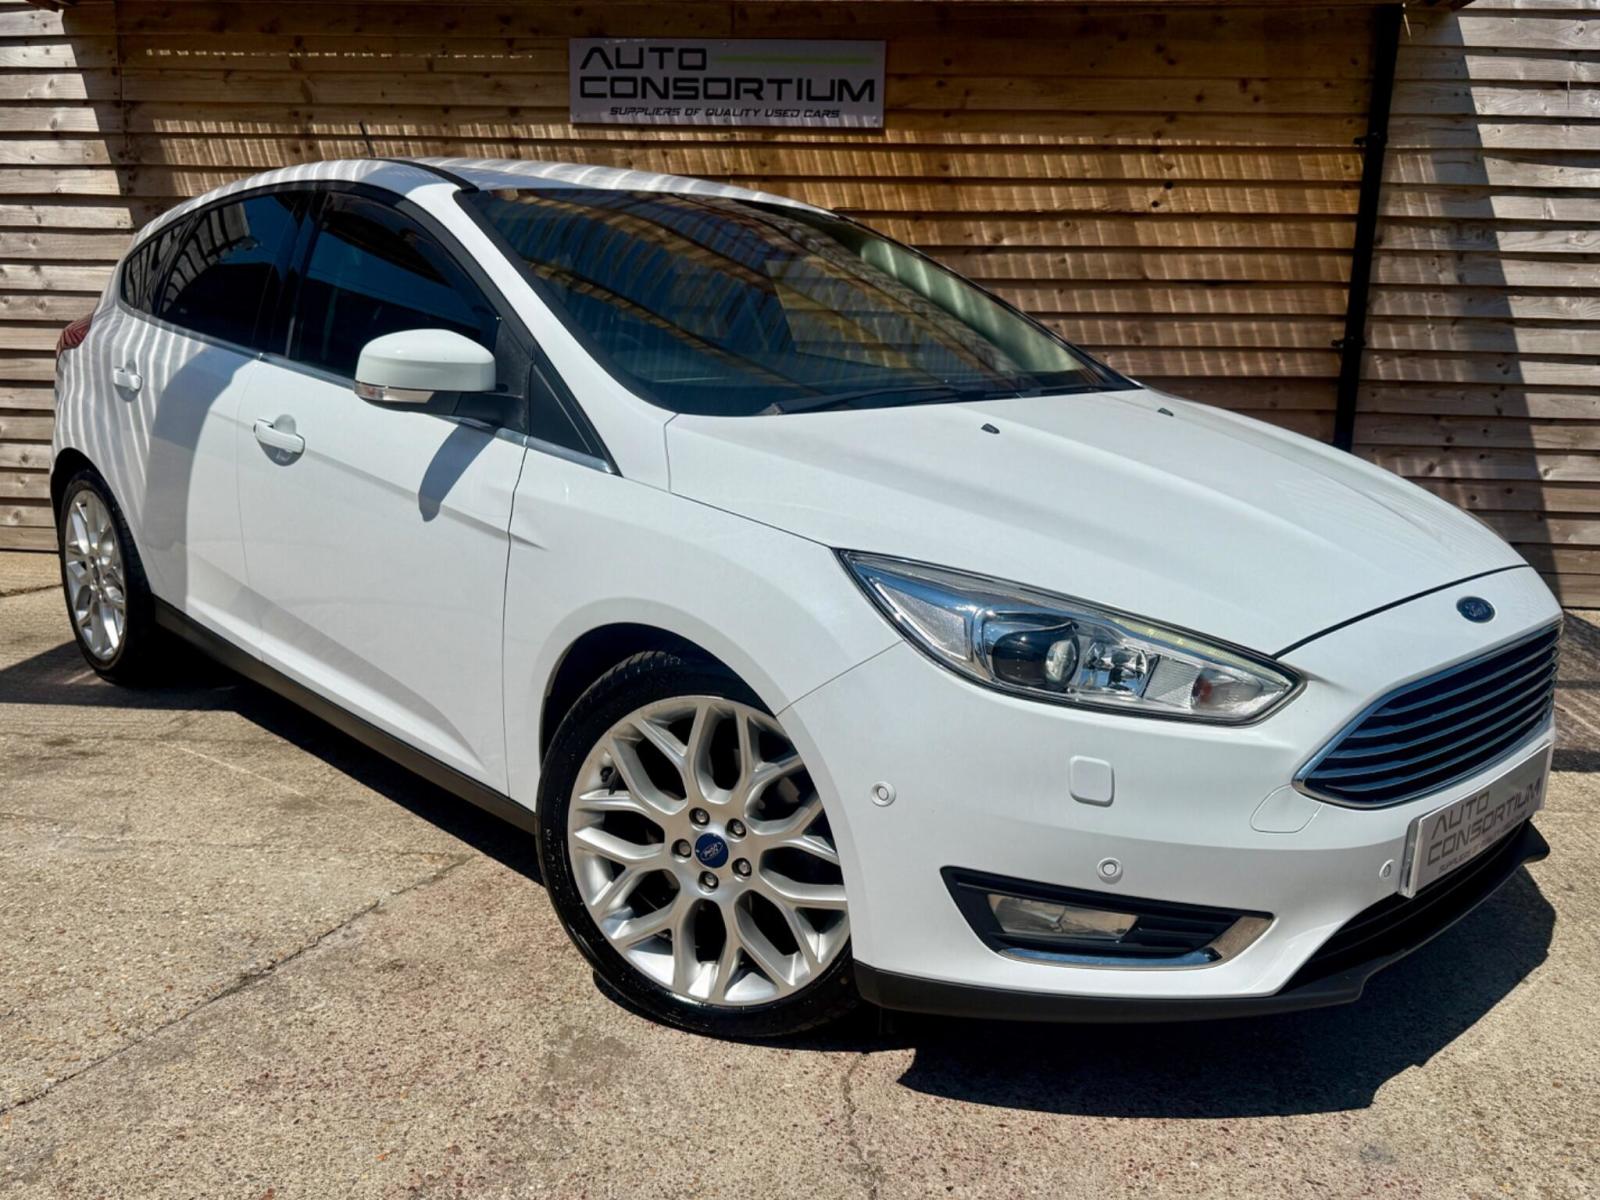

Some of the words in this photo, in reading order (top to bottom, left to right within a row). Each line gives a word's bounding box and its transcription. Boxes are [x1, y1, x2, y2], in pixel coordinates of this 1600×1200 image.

[580, 47, 707, 71] AUTO
[580, 76, 875, 102] CONSORTIUM
[610, 106, 681, 116] SUPPLIERS
[684, 107, 702, 116] OF
[705, 107, 761, 117] QUALITY
[765, 108, 800, 118] USED
[803, 109, 841, 118] CARS
[1427, 777, 1541, 866] CONSORTIUM
[1431, 791, 1490, 841] AUTO
